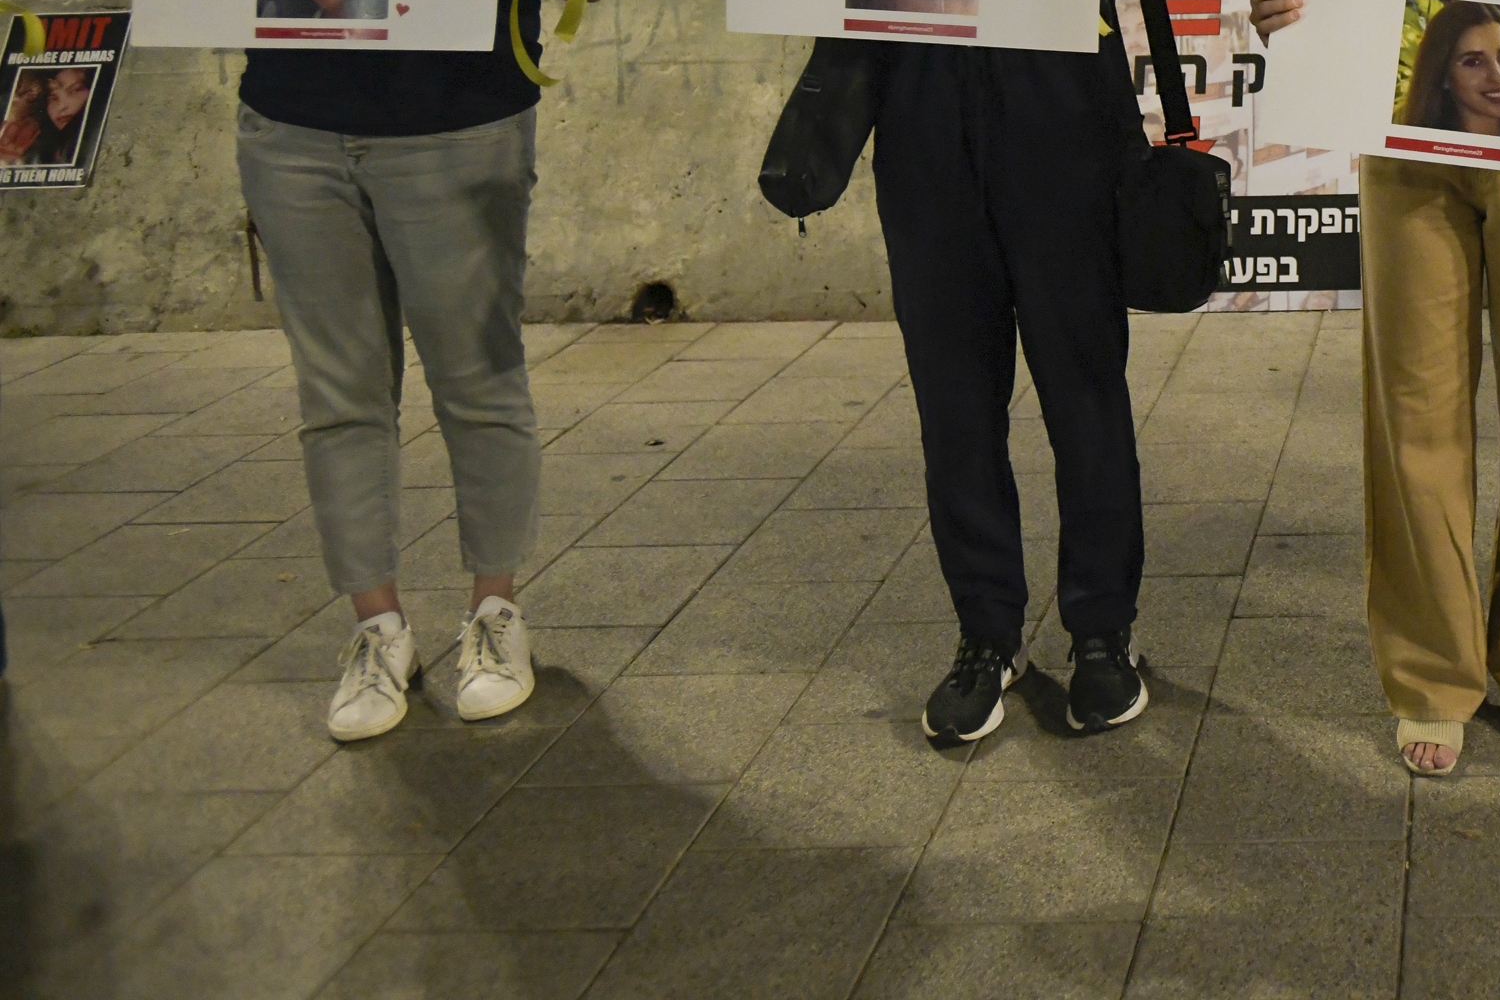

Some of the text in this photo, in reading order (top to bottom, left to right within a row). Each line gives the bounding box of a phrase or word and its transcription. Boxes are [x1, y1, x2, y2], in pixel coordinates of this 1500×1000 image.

[41, 16, 112, 49] MIT
[59, 51, 74, 63] OF
[74, 50, 115, 62] HAMAS
[14, 170, 47, 183] THEM
[48, 168, 85, 181] HOME
[1250, 207, 1359, 242] הפקרת
